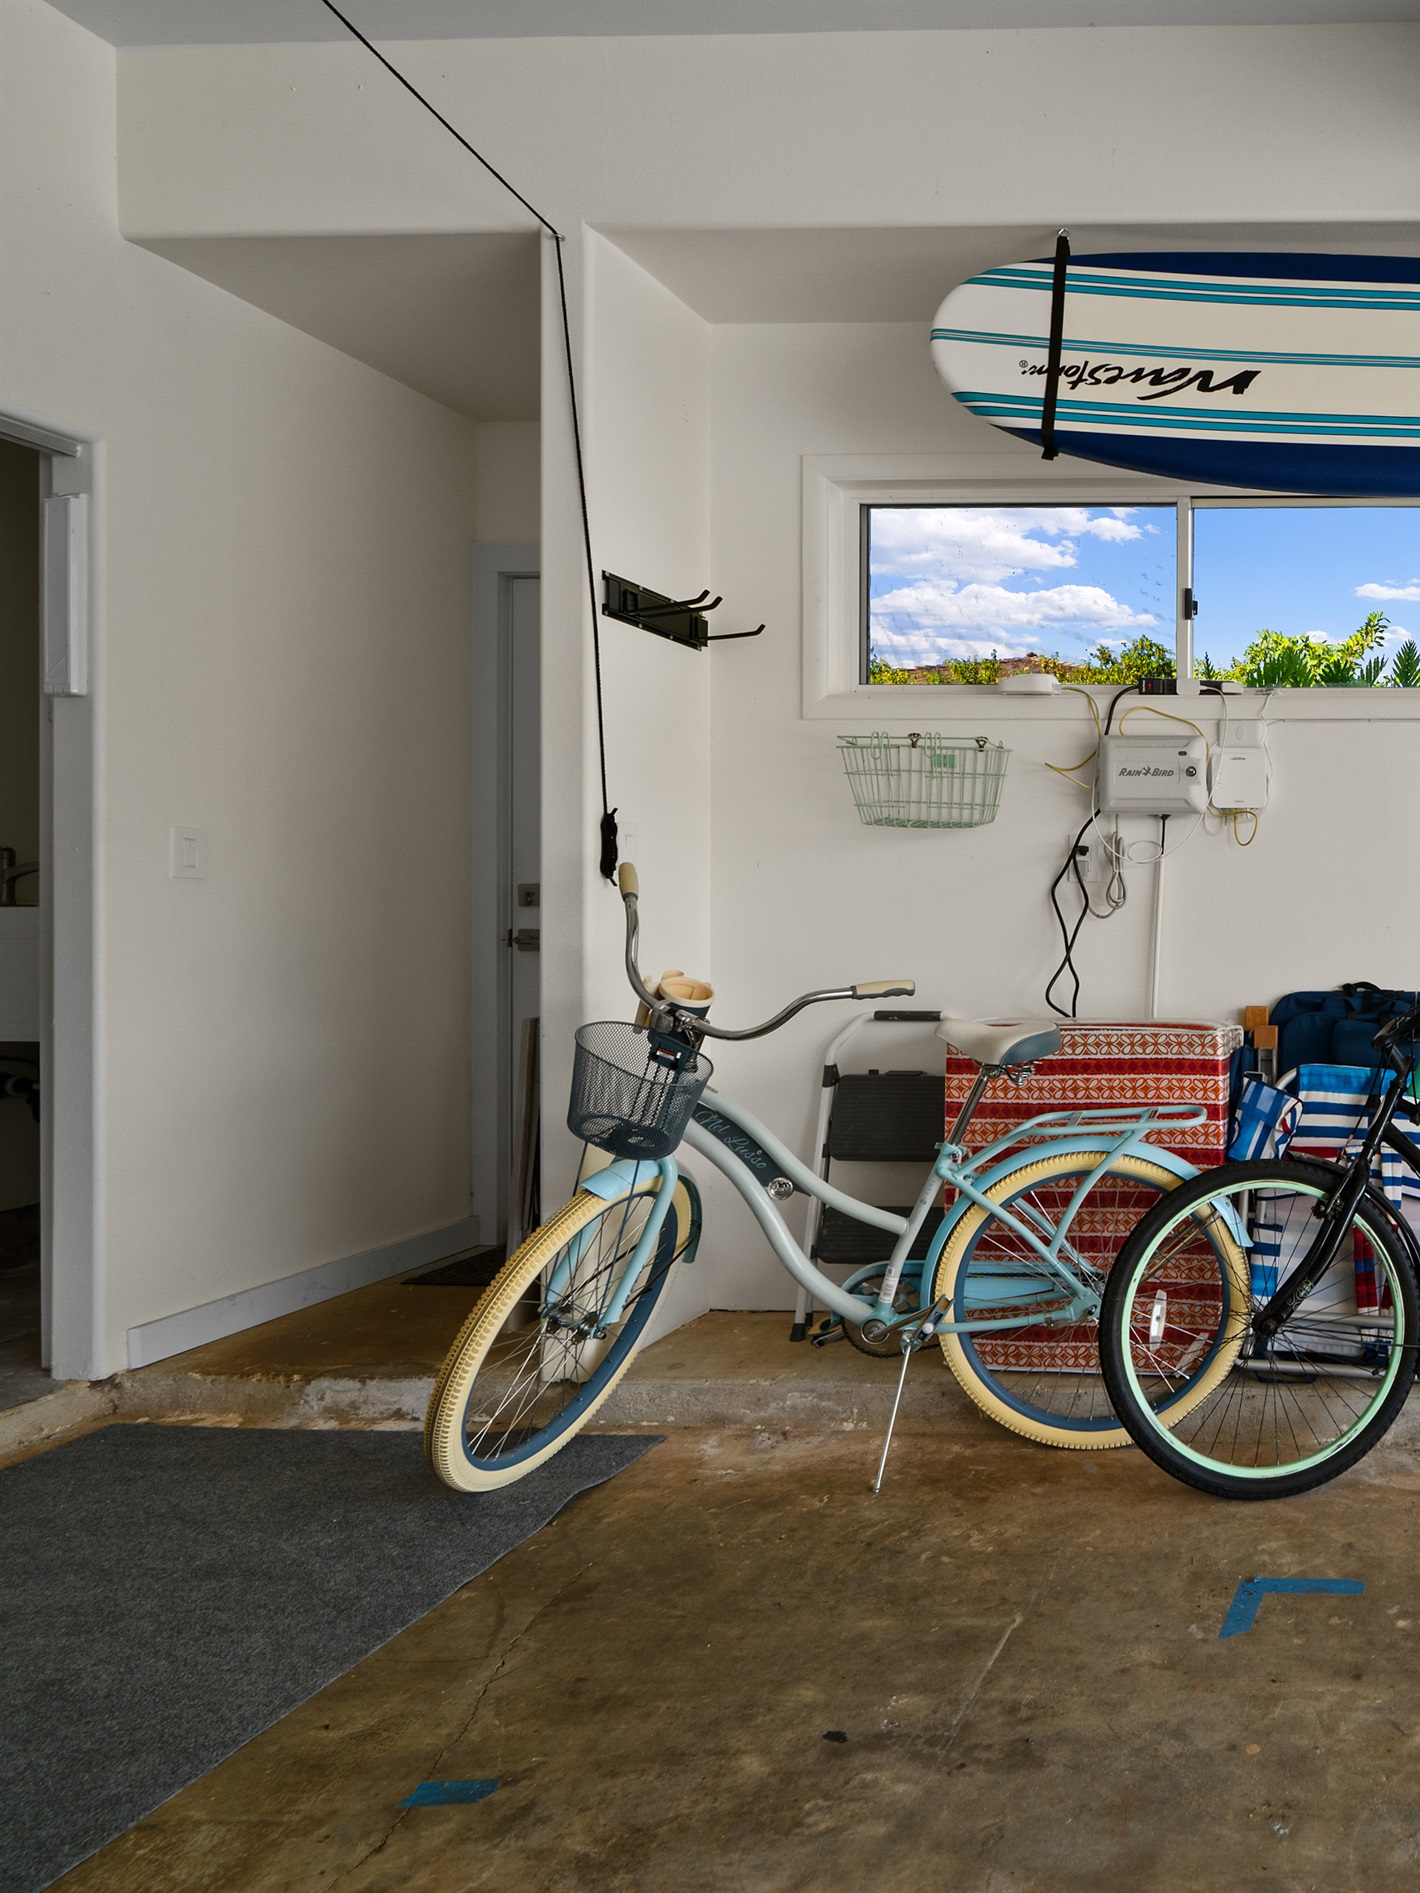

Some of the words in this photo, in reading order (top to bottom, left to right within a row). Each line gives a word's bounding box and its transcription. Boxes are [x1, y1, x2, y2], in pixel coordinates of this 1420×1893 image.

[1118, 767, 1143, 777] RAIN
[1151, 767, 1175, 777] BIRD
[723, 1136, 767, 1169] Lusso
